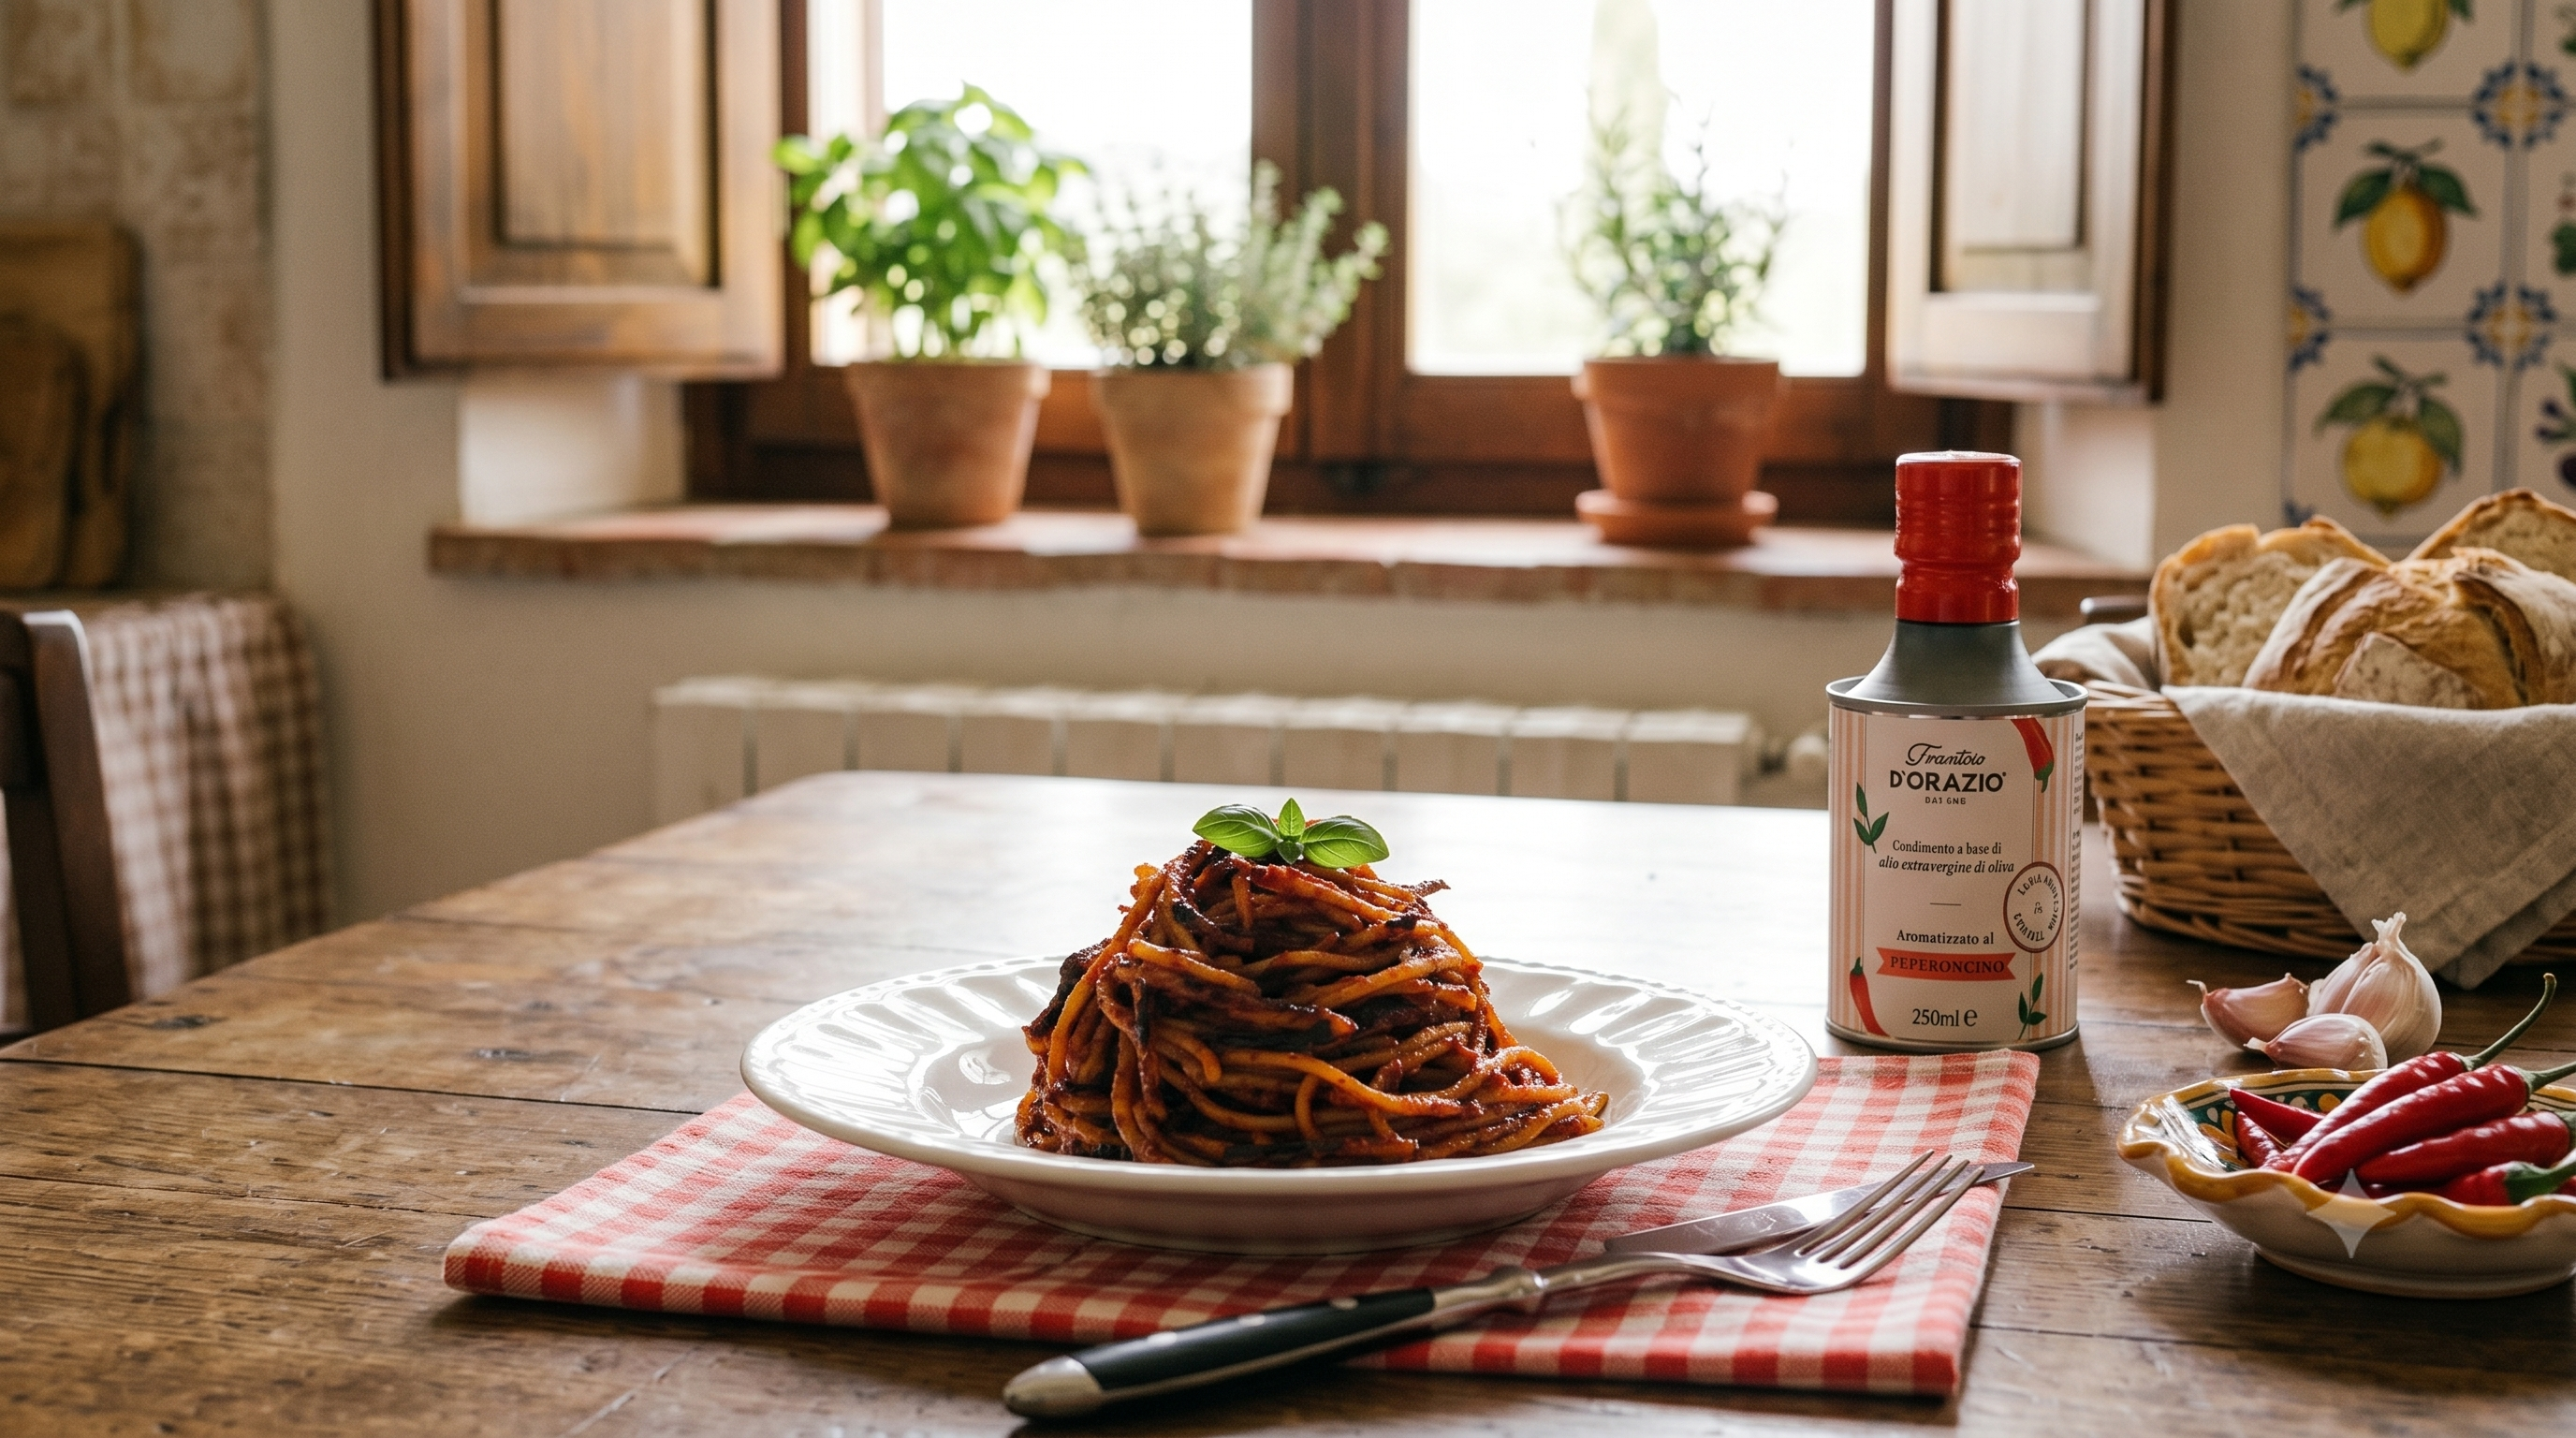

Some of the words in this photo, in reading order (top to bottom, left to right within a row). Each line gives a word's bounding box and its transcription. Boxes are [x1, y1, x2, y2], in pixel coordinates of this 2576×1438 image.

[1905, 742, 1986, 766] Frantoio
[1893, 839, 1955, 855] Condimento
[1957, 845, 1963, 855] a
[1966, 842, 1989, 855] base
[1992, 842, 2002, 855] di
[1901, 858, 1972, 876] extravergine
[1973, 859, 1986, 873] di
[1987, 859, 2014, 873] oliva
[1896, 929, 1980, 945] Aromatizzato
[1983, 932, 1995, 945] al
[1890, 956, 2005, 974] PEPERONCINO
[1911, 1008, 1960, 1027] 250ml
